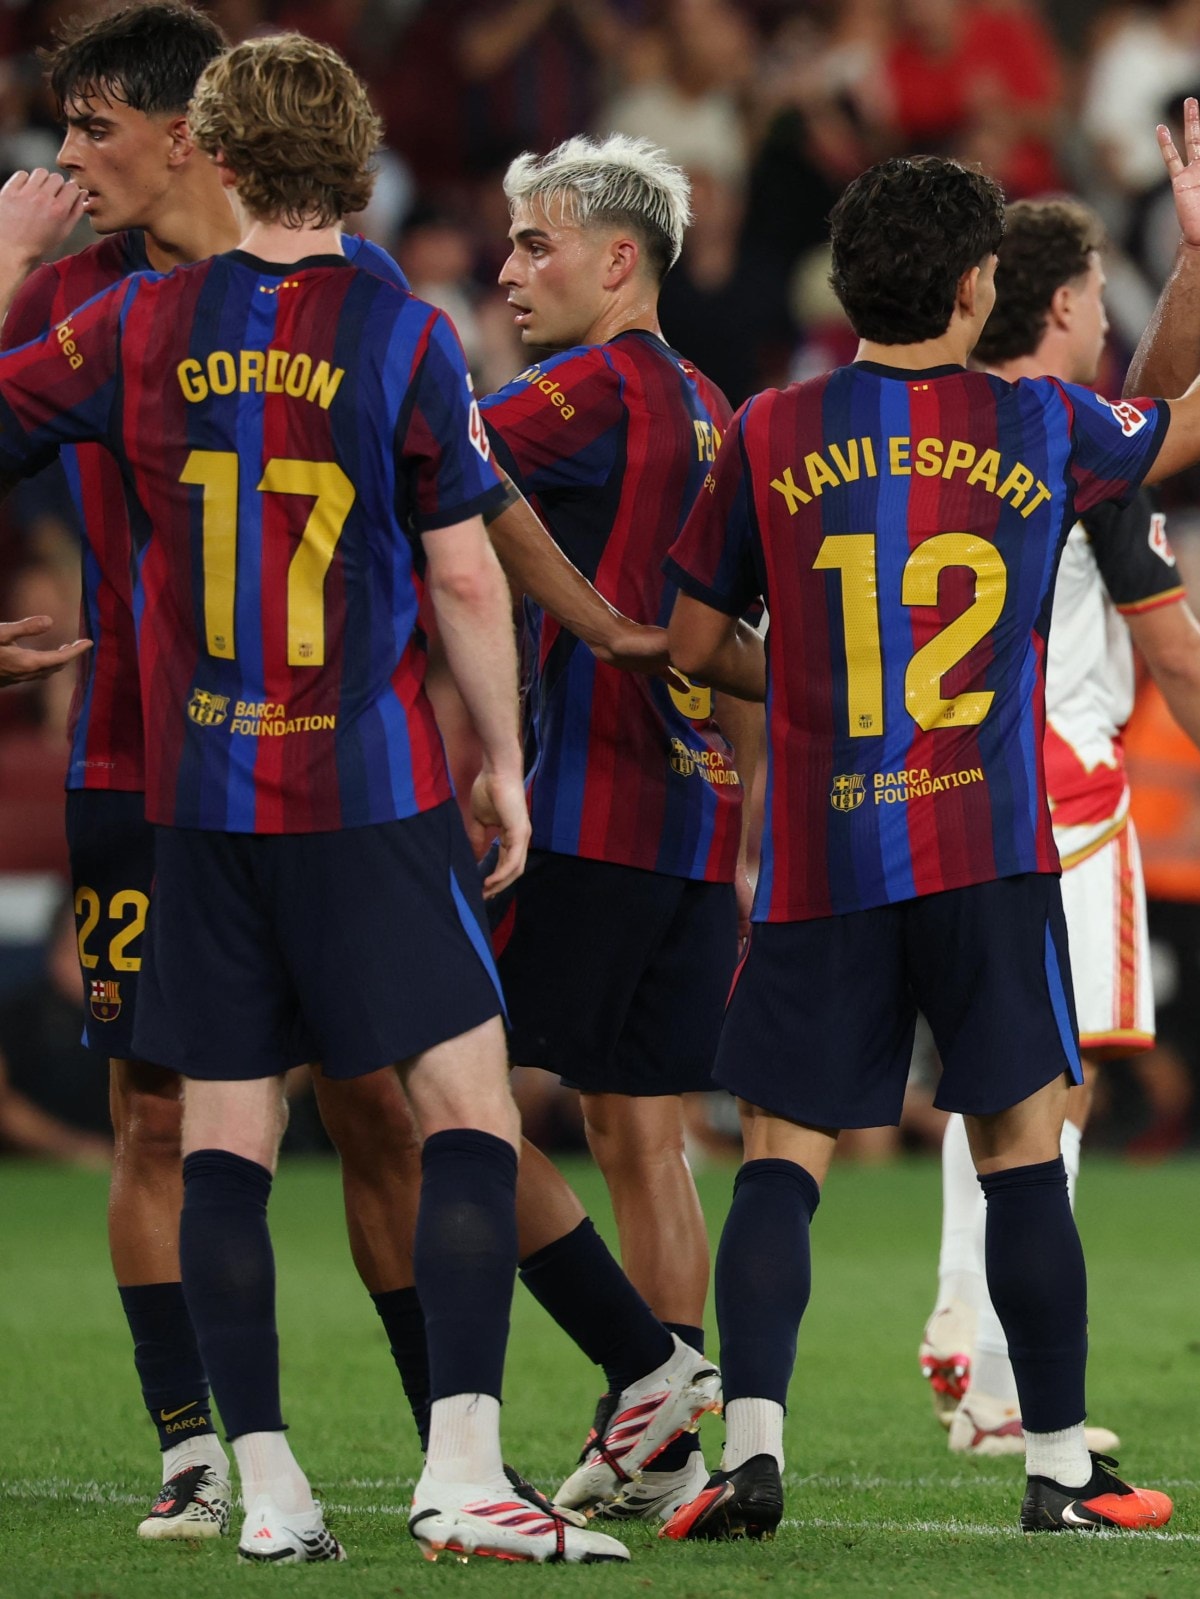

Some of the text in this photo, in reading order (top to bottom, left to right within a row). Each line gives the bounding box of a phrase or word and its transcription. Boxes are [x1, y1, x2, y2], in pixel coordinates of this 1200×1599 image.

[55, 313, 84, 370] idea
[177, 349, 345, 410] GORDON
[769, 436, 1052, 519] XAVI ESPART
[178, 449, 356, 666] 17
[811, 532, 1007, 738] 12
[230, 715, 336, 736] FOUNDATION
[234, 701, 286, 721] BARÇA
[873, 768, 931, 789] BARÇA
[874, 767, 984, 805] FOUNDATION
[75, 886, 150, 972] 22
[165, 1415, 207, 1434] BARÇA
